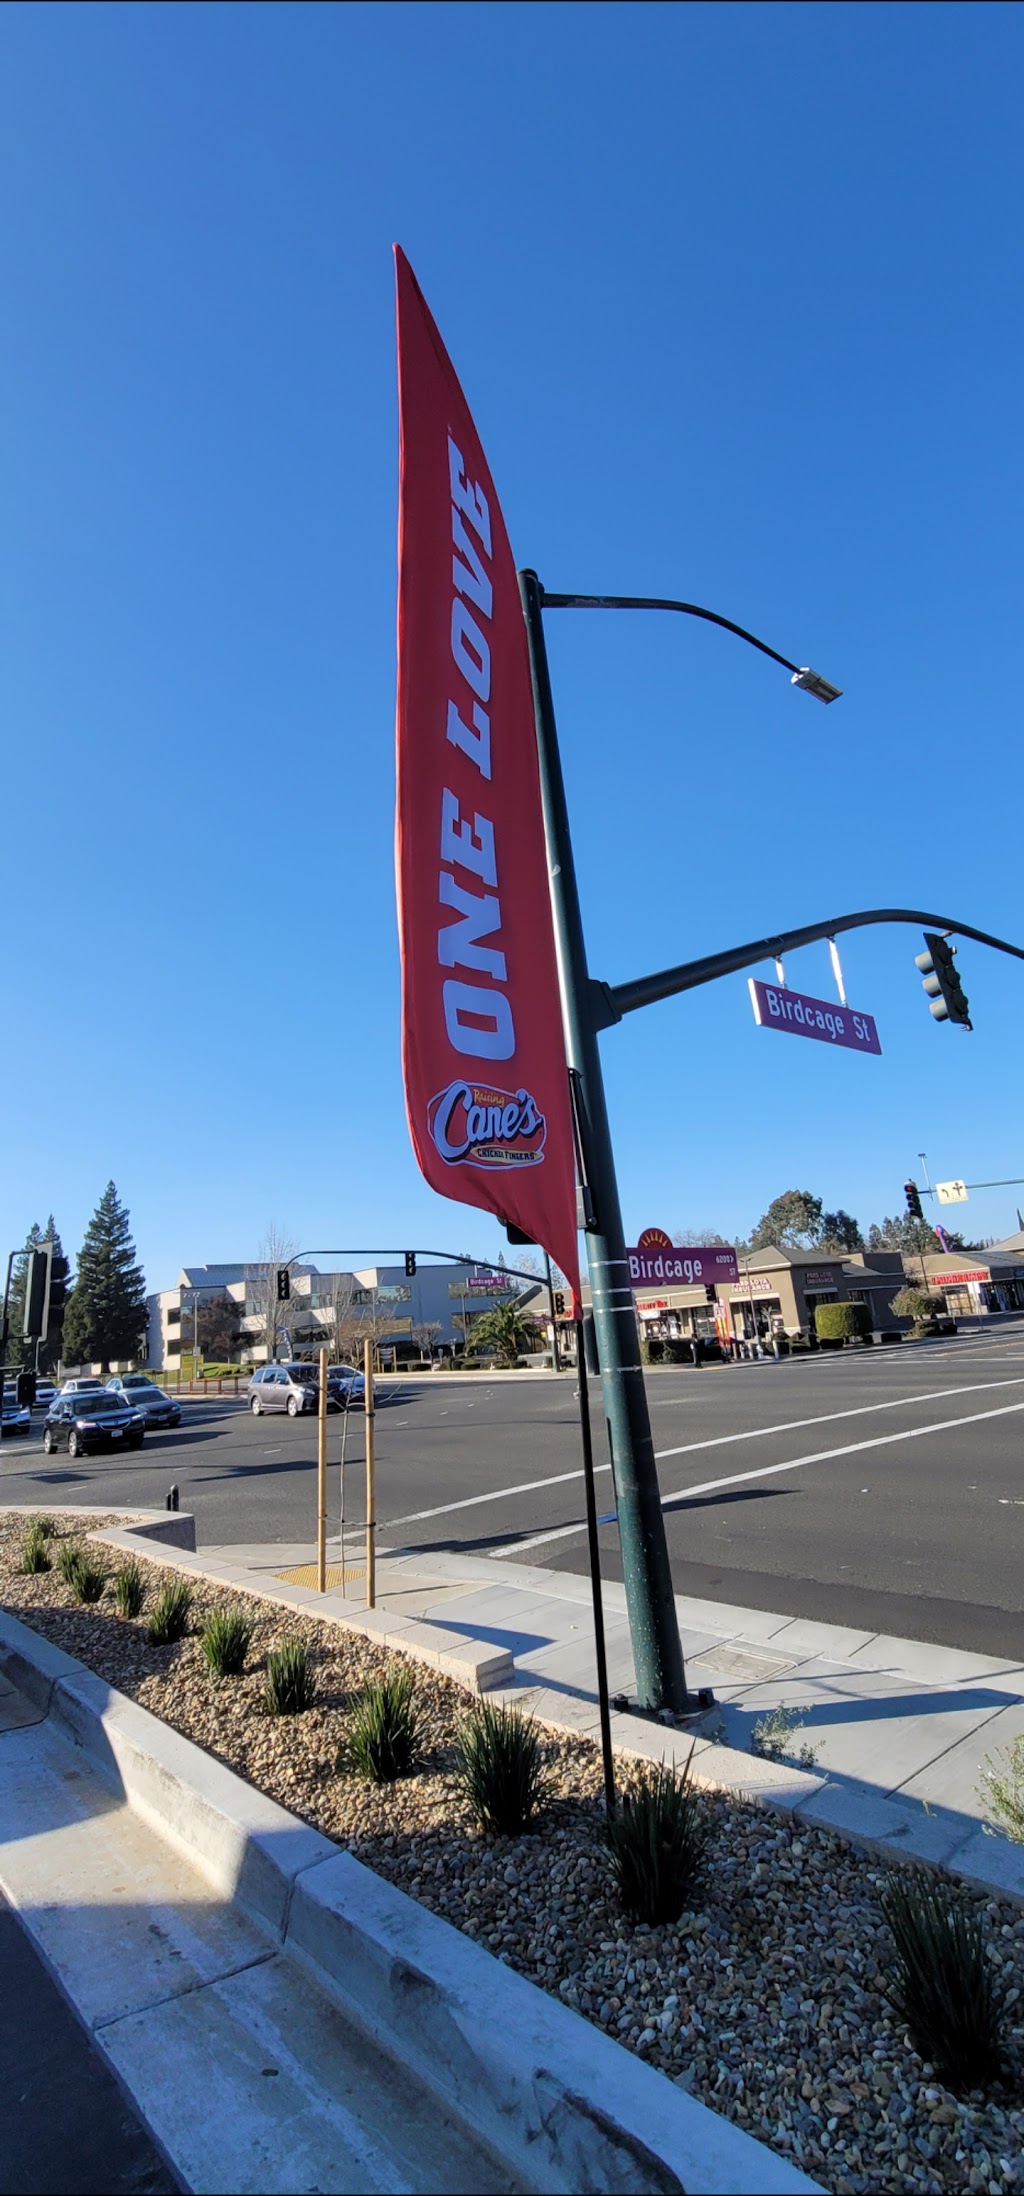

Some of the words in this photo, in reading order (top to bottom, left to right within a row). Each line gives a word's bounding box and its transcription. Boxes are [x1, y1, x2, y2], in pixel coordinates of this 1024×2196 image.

[446, 434, 493, 781] LOVE
[438, 787, 515, 1060] ONE
[766, 989, 844, 1039] Birdcage
[853, 1015, 870, 1042] St
[473, 1088, 505, 1107] Raising
[433, 1081, 542, 1160] Cane's
[505, 1151, 535, 1160] FINGERS
[470, 1278, 494, 1286] Birdcage
[628, 1255, 702, 1284] Birdcage
